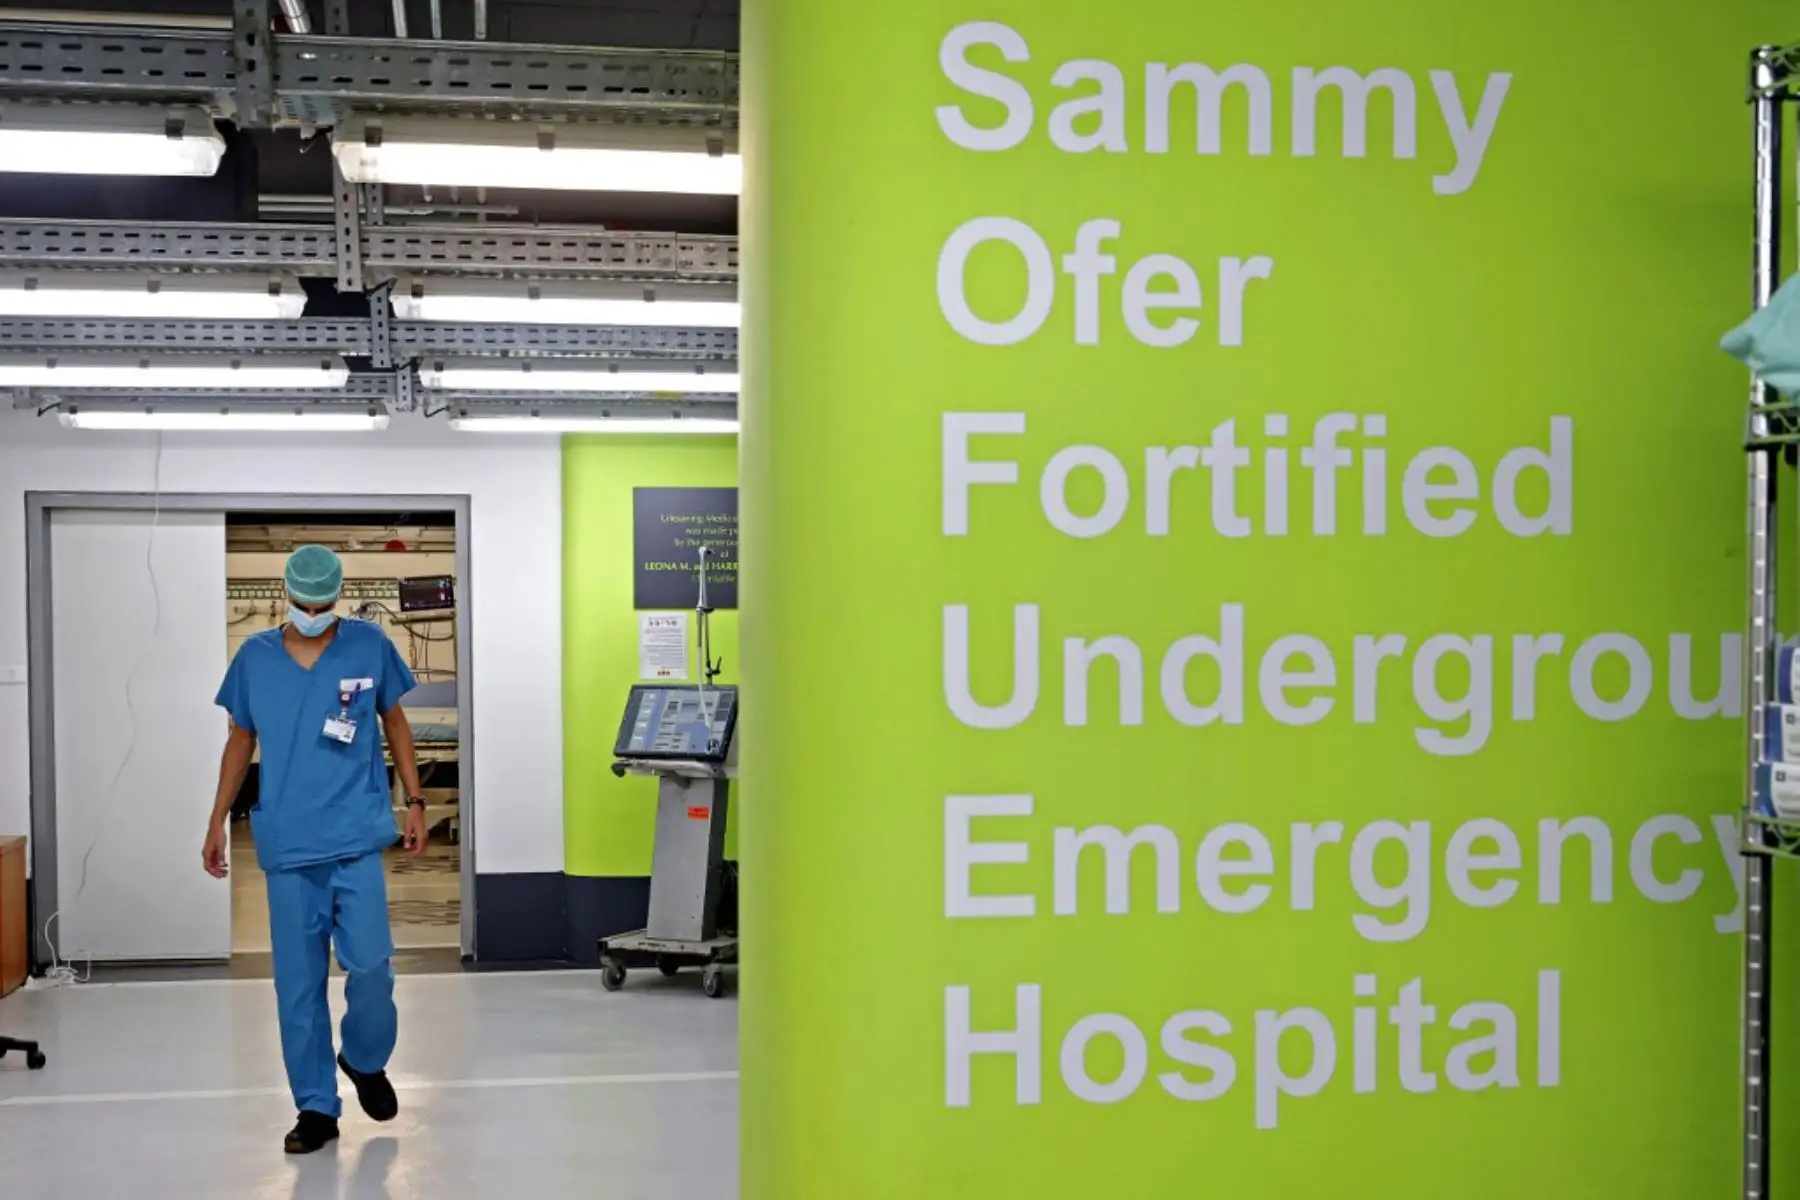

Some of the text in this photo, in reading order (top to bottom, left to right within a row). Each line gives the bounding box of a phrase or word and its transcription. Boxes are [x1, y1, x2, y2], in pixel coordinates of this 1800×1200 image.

[935, 20, 1513, 196] Sammy
[936, 216, 1275, 347] Ofer
[940, 411, 1574, 539] Fortified
[644, 561, 678, 571] LEONA
[942, 602, 1800, 757] Undergrou
[943, 968, 1562, 1130] Hospital
